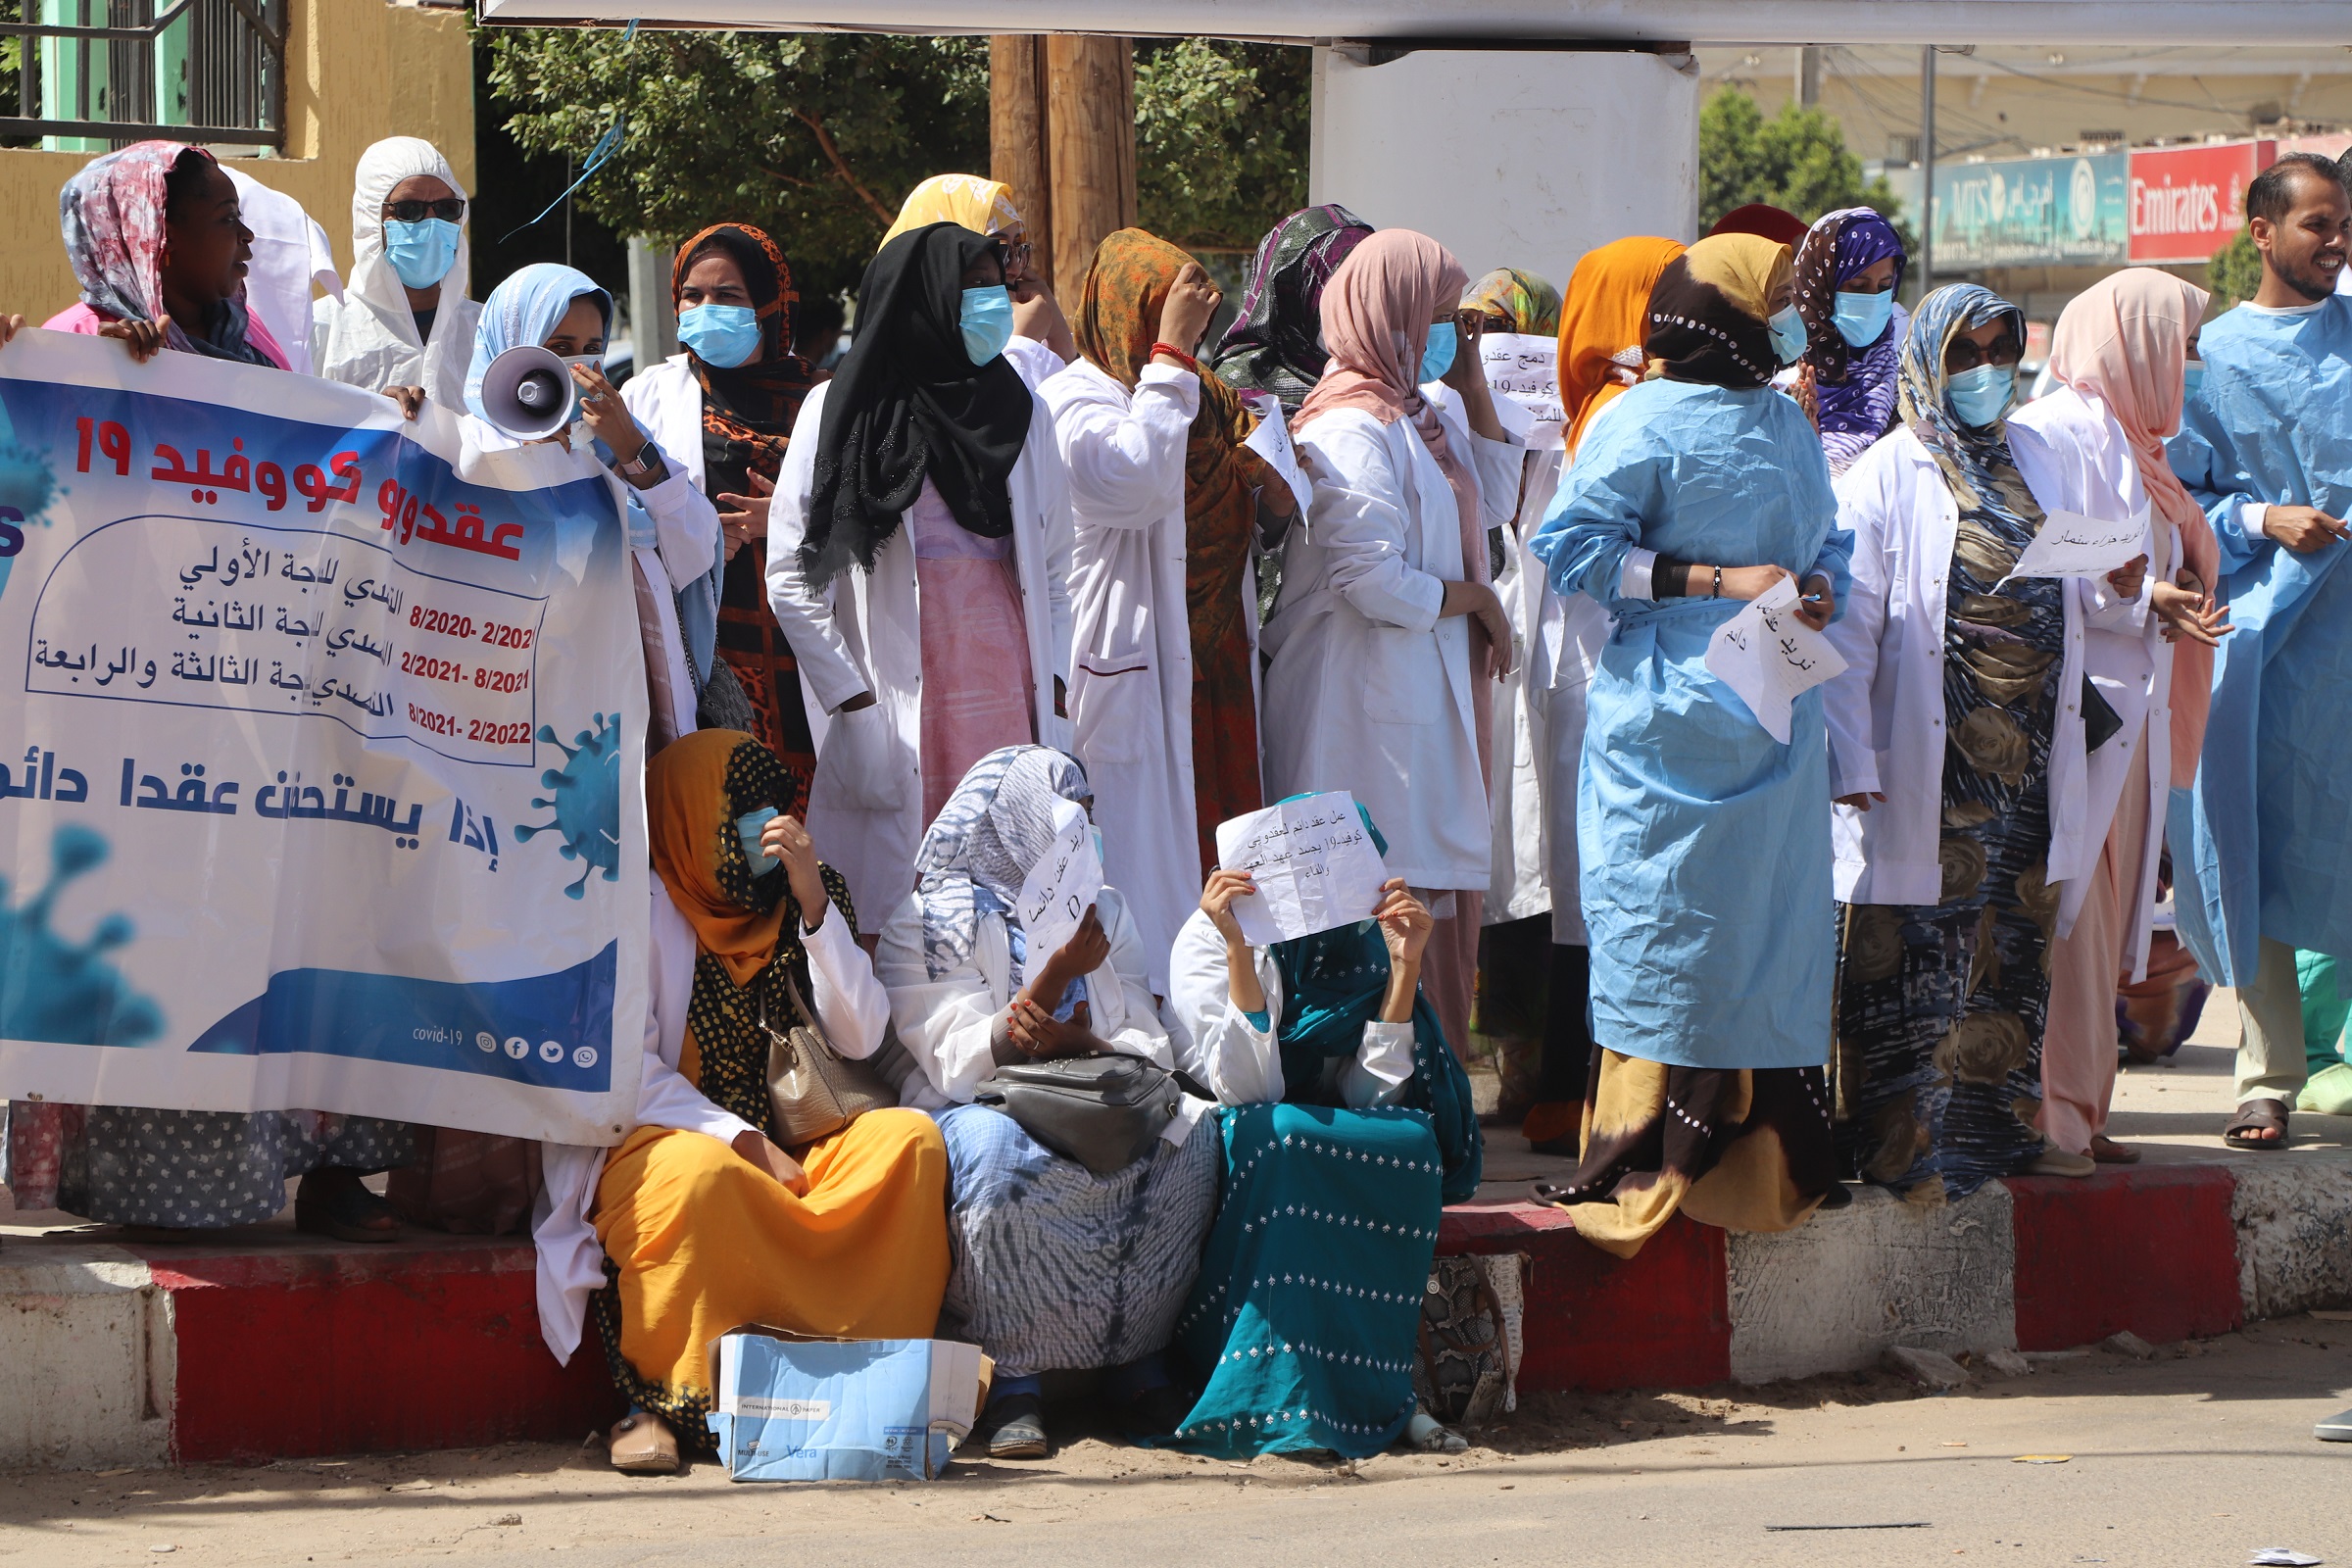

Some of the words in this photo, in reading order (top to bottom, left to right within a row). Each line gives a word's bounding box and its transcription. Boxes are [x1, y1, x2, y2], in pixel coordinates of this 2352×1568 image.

[2131, 172, 2219, 235] Emirates
[1482, 347, 1512, 366] عقدو
[1518, 354, 1545, 370] دمج
[172, 597, 264, 640] الثانية
[34, 639, 157, 688] والرابعة
[171, 651, 259, 685] الثالثة
[1781, 638, 1816, 671] نريد
[473, 667, 529, 694] 8/2021
[467, 718, 532, 745] 2/2022
[120, 758, 240, 815] عقدا
[448, 797, 499, 872] إذا
[1311, 814, 1326, 828] عقد
[413, 1026, 463, 1046] covid-19
[741, 1403, 789, 1412] INTERNATIONAL
[786, 1445, 817, 1458] Vera
